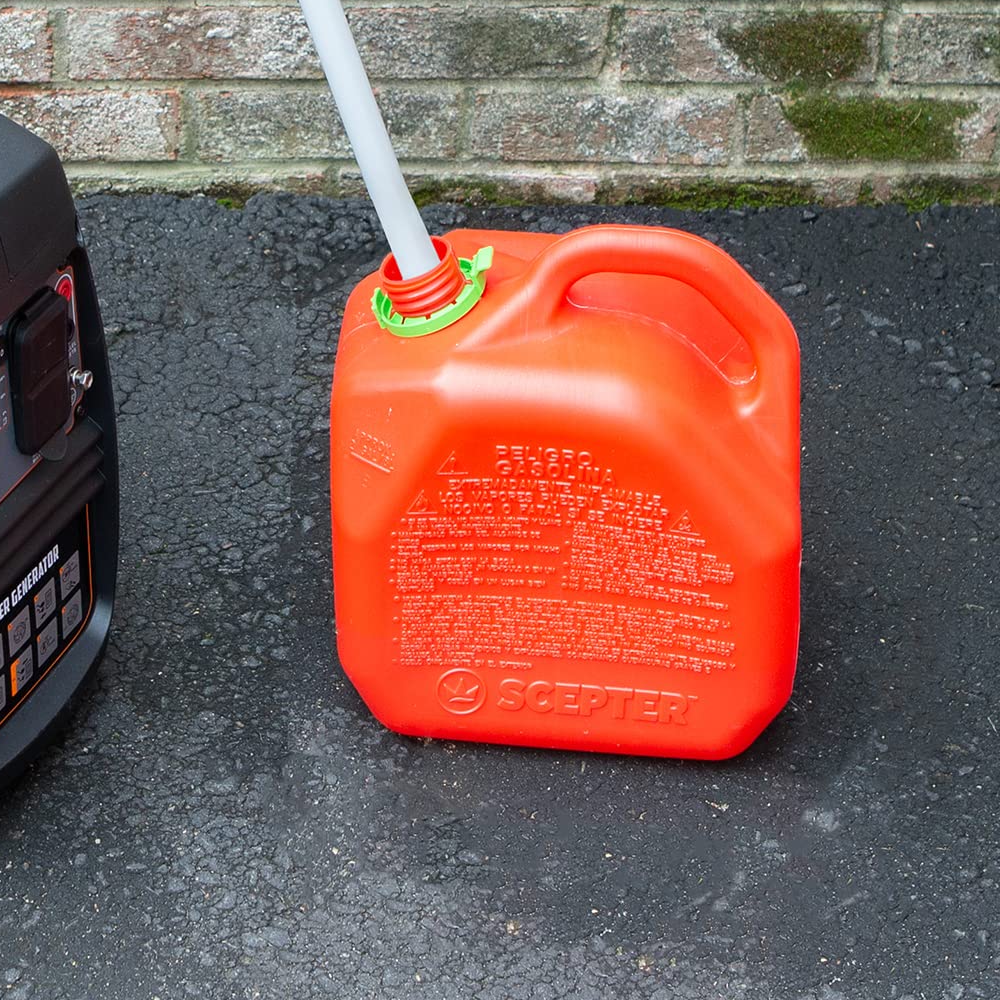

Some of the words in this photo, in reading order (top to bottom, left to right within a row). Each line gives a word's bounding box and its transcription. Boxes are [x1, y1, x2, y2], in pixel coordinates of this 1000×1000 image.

[495, 444, 593, 467] PELIGRO
[495, 459, 617, 485] GASOLINA
[448, 478, 572, 493] EXTREMADAMENTE
[439, 490, 464, 503] LOS
[472, 490, 533, 504] VAPORES
[541, 492, 594, 508] PUEDEN
[443, 502, 494, 515] NOCIVO
[502, 502, 511, 514] O
[519, 503, 562, 518] FATAL
[587, 509, 605, 523] SE
[10, 543, 60, 607] GENERATOR
[497, 677, 690, 726] SCEPTER
